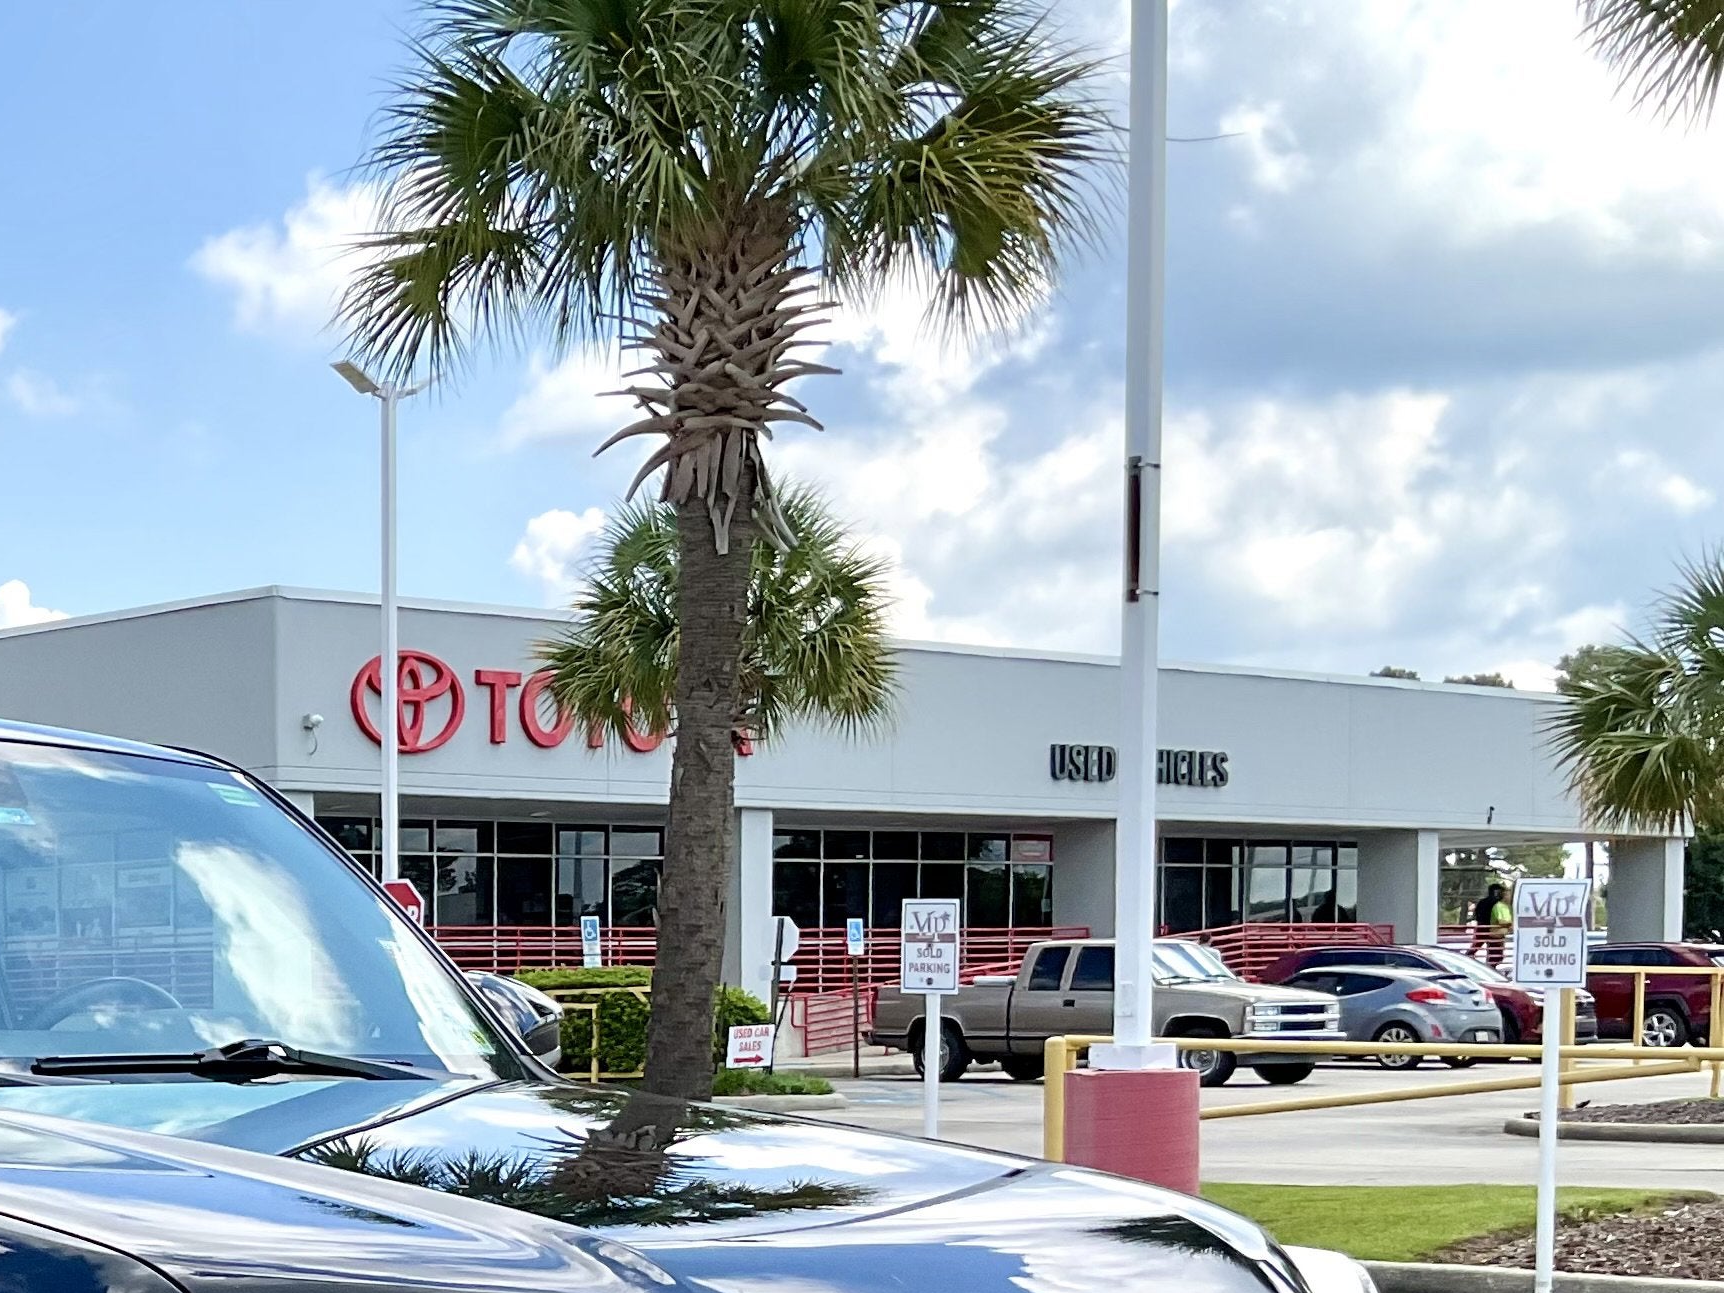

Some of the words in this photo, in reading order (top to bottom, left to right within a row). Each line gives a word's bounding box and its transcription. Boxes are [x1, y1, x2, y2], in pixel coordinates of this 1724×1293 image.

[1050, 744, 1116, 782] USED
[1156, 749, 1229, 787] HICLES
[1533, 935, 1567, 948] SOLD
[917, 948, 943, 959] SOLD
[1522, 953, 1577, 966] PARKING
[908, 962, 950, 974] PARKING
[733, 1028, 753, 1039] USED
[754, 1027, 769, 1037] CAR
[739, 1041, 762, 1051] SALES
